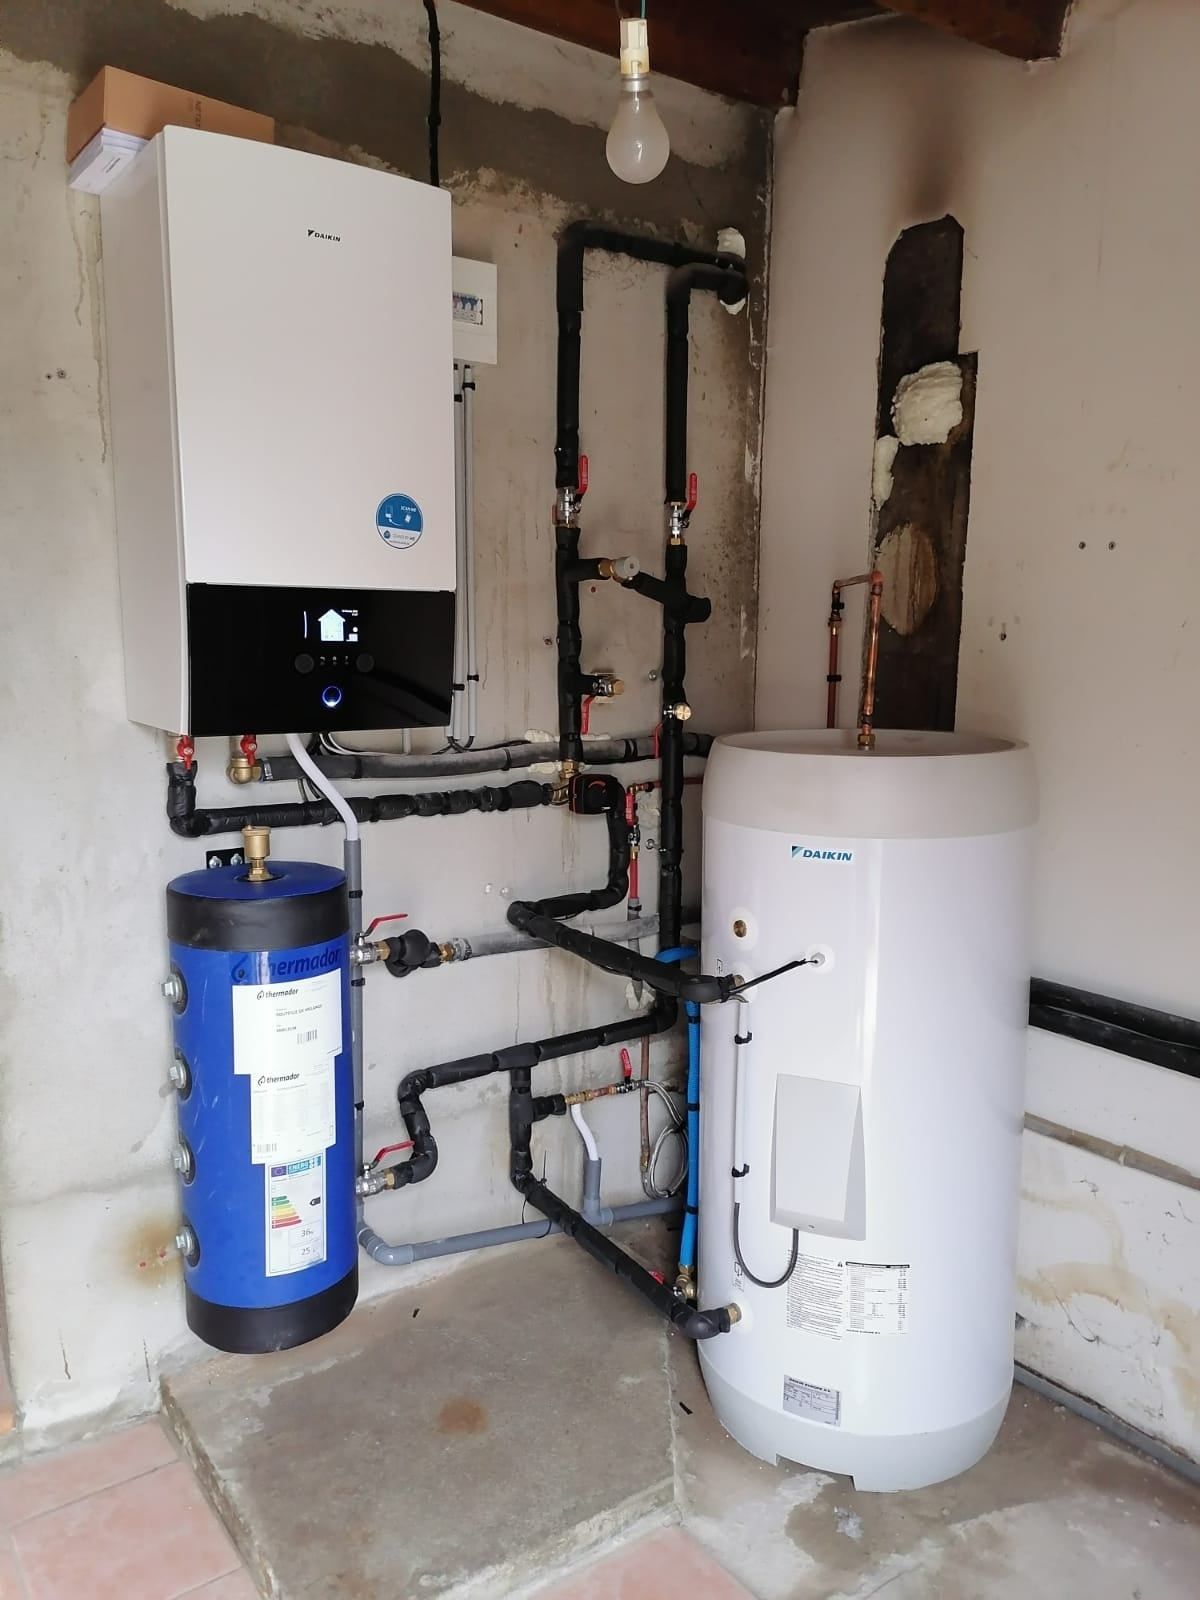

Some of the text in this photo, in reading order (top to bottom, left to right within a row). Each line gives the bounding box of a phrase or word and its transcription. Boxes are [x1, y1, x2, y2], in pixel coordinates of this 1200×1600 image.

[315, 232, 341, 242] DAIKIN
[803, 849, 853, 861] DAIKIN
[265, 987, 299, 998] thermador
[266, 1072, 300, 1084] thermador
